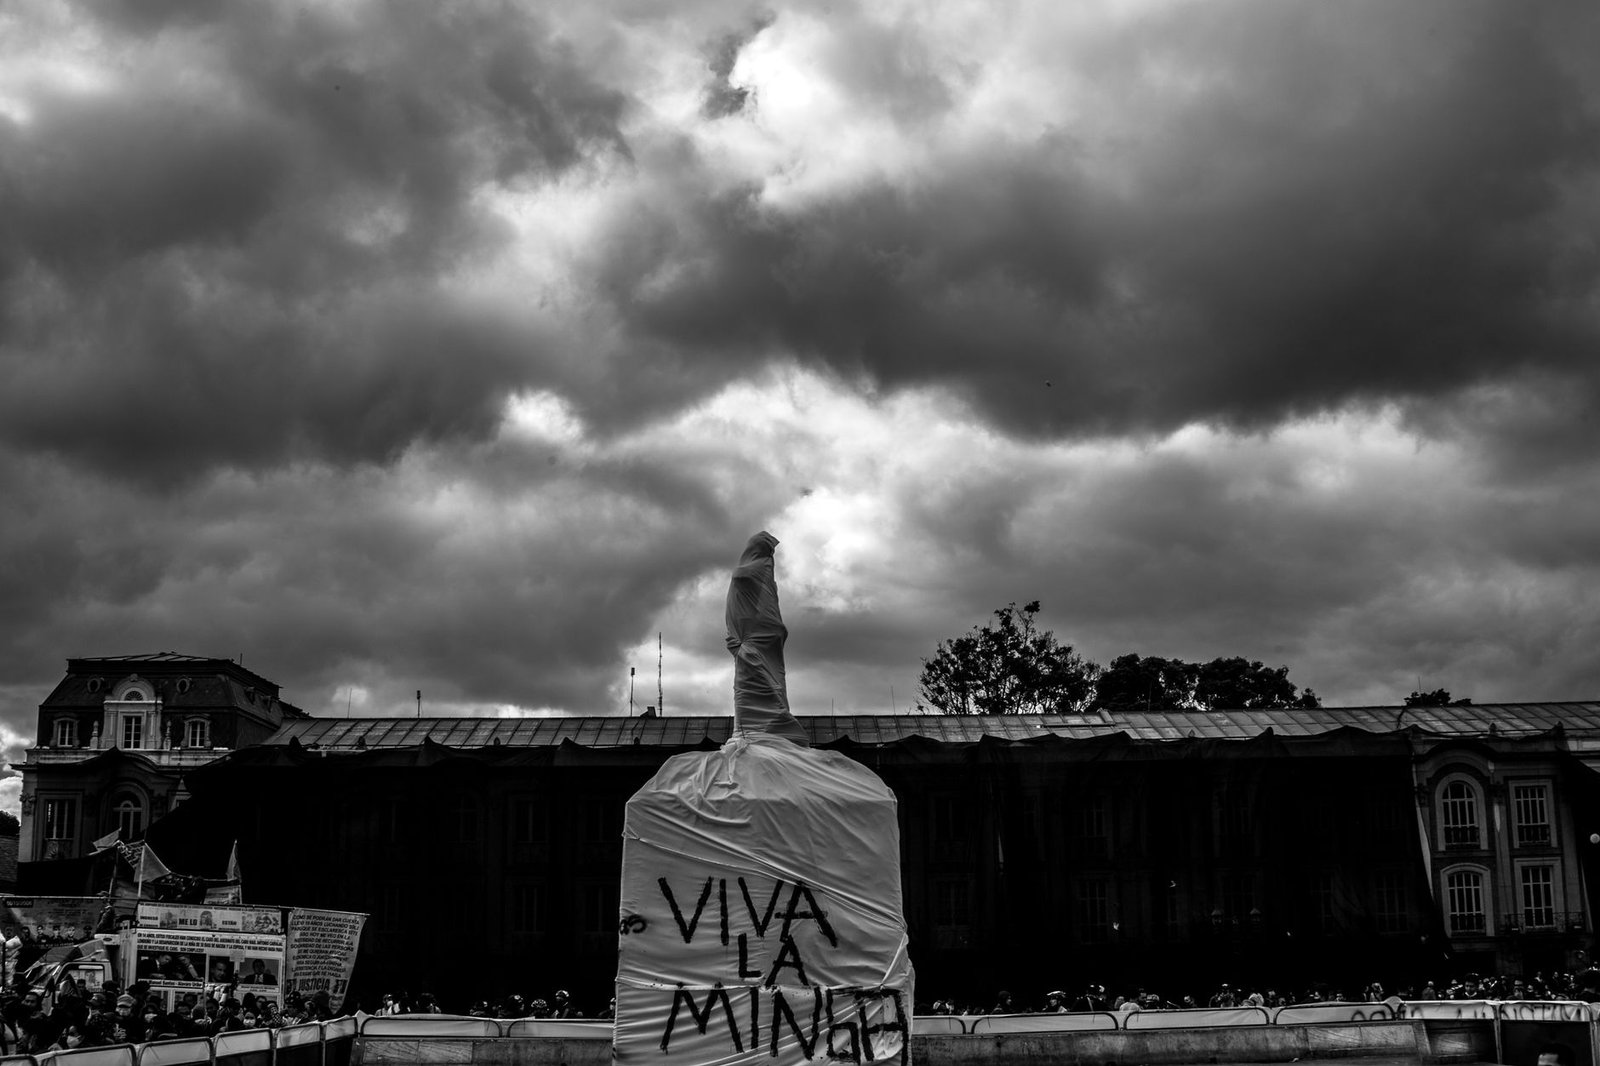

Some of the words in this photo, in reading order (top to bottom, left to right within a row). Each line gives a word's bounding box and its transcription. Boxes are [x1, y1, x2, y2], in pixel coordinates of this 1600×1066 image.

[657, 876, 838, 948] VIVA
[298, 978, 330, 991] JUSTICIA
[738, 932, 809, 988] LA
